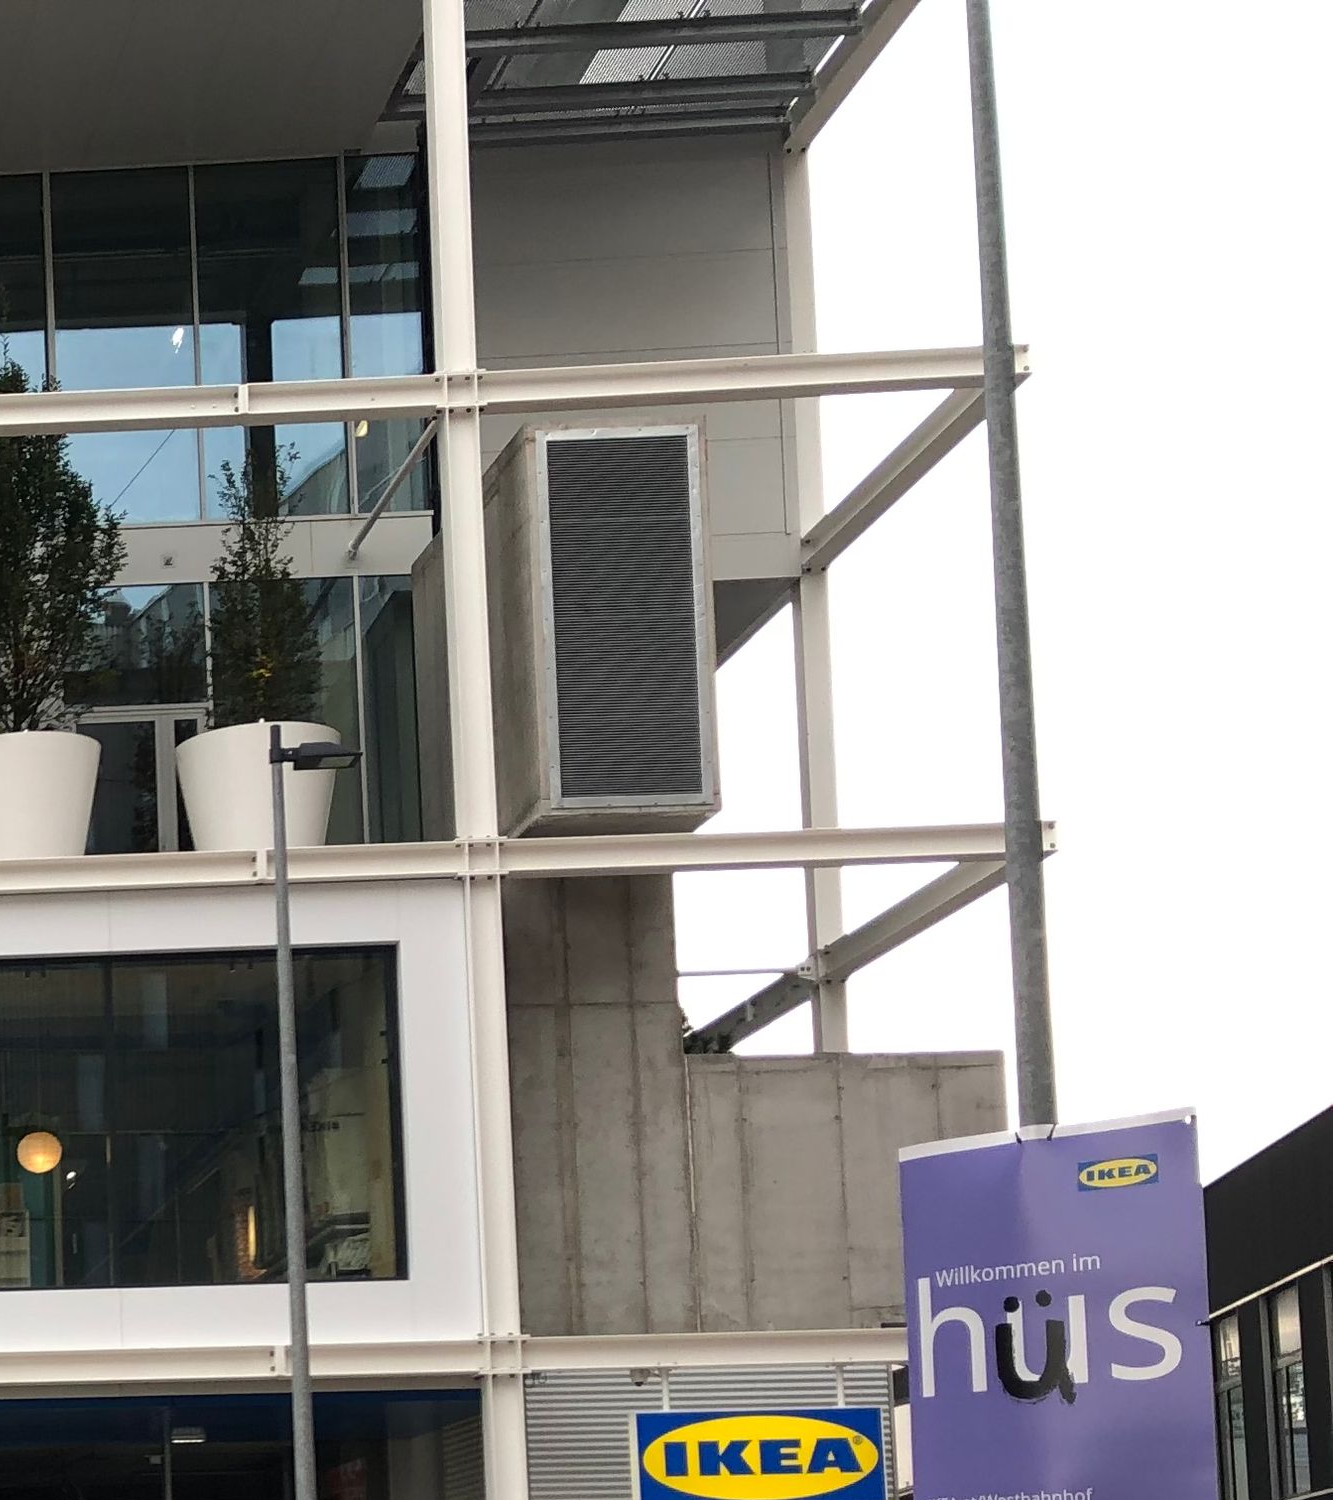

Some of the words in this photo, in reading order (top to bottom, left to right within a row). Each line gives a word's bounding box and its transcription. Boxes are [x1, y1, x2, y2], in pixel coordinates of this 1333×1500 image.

[1086, 1160, 1152, 1184] IKEA
[936, 1259, 1065, 1288] Willkommen
[1073, 1252, 1101, 1272] im
[917, 1276, 1183, 1404] hüs
[662, 1436, 863, 1477] IKEA
